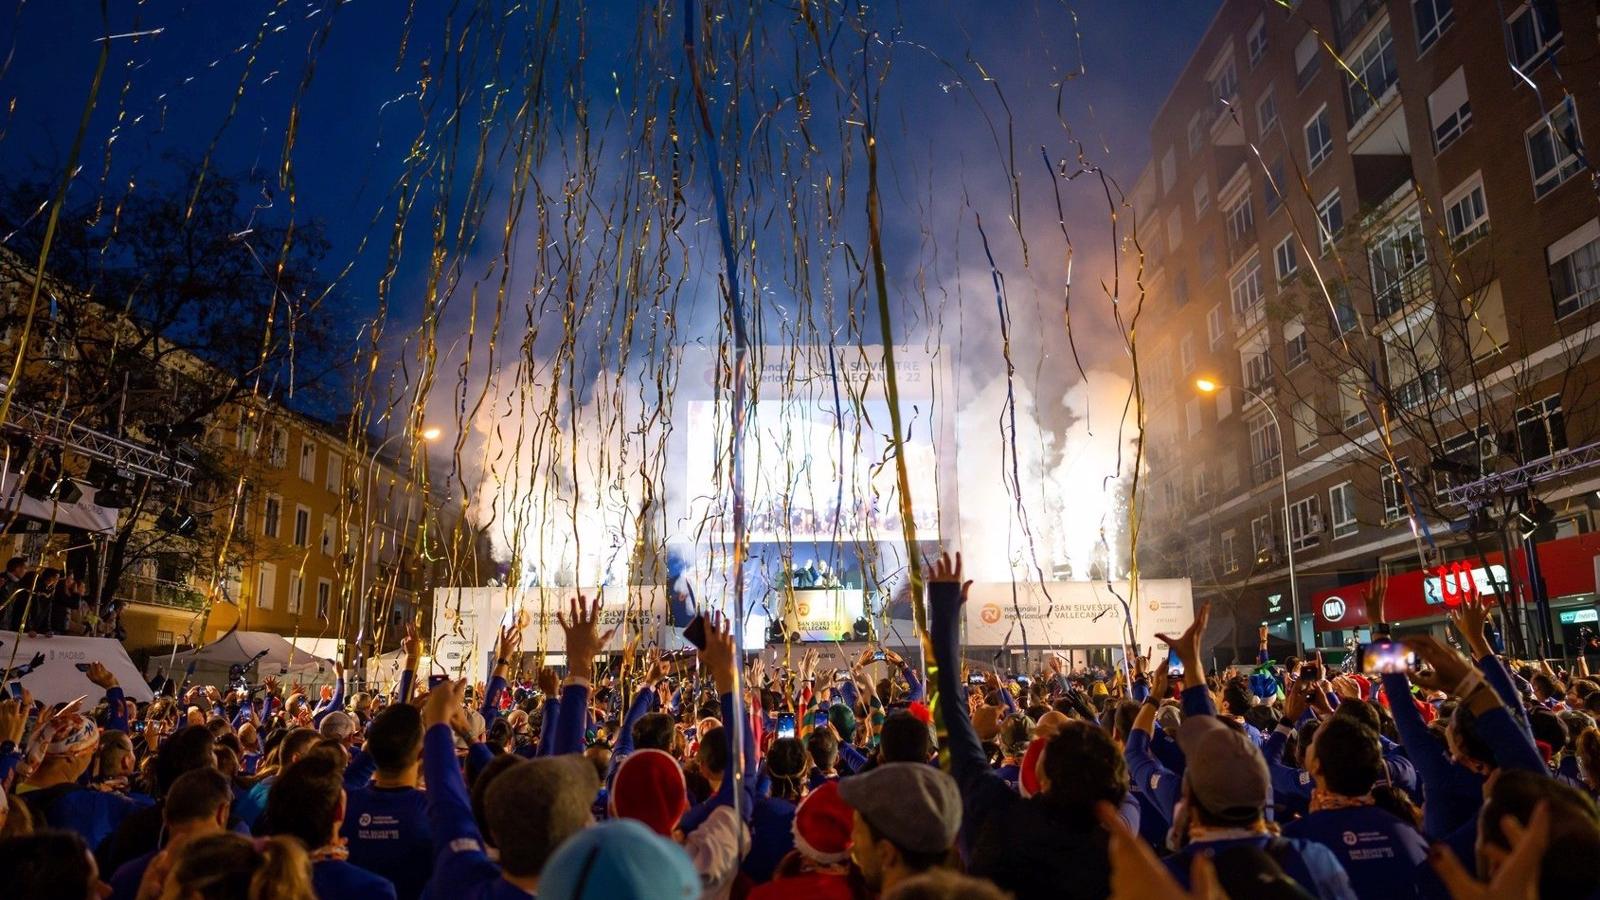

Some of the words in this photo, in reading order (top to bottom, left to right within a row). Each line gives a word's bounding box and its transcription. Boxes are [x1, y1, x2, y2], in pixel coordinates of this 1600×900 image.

[850, 362, 919, 371] SILVETRE
[1054, 604, 1072, 612] SAN
[1325, 601, 1342, 617] KIA
